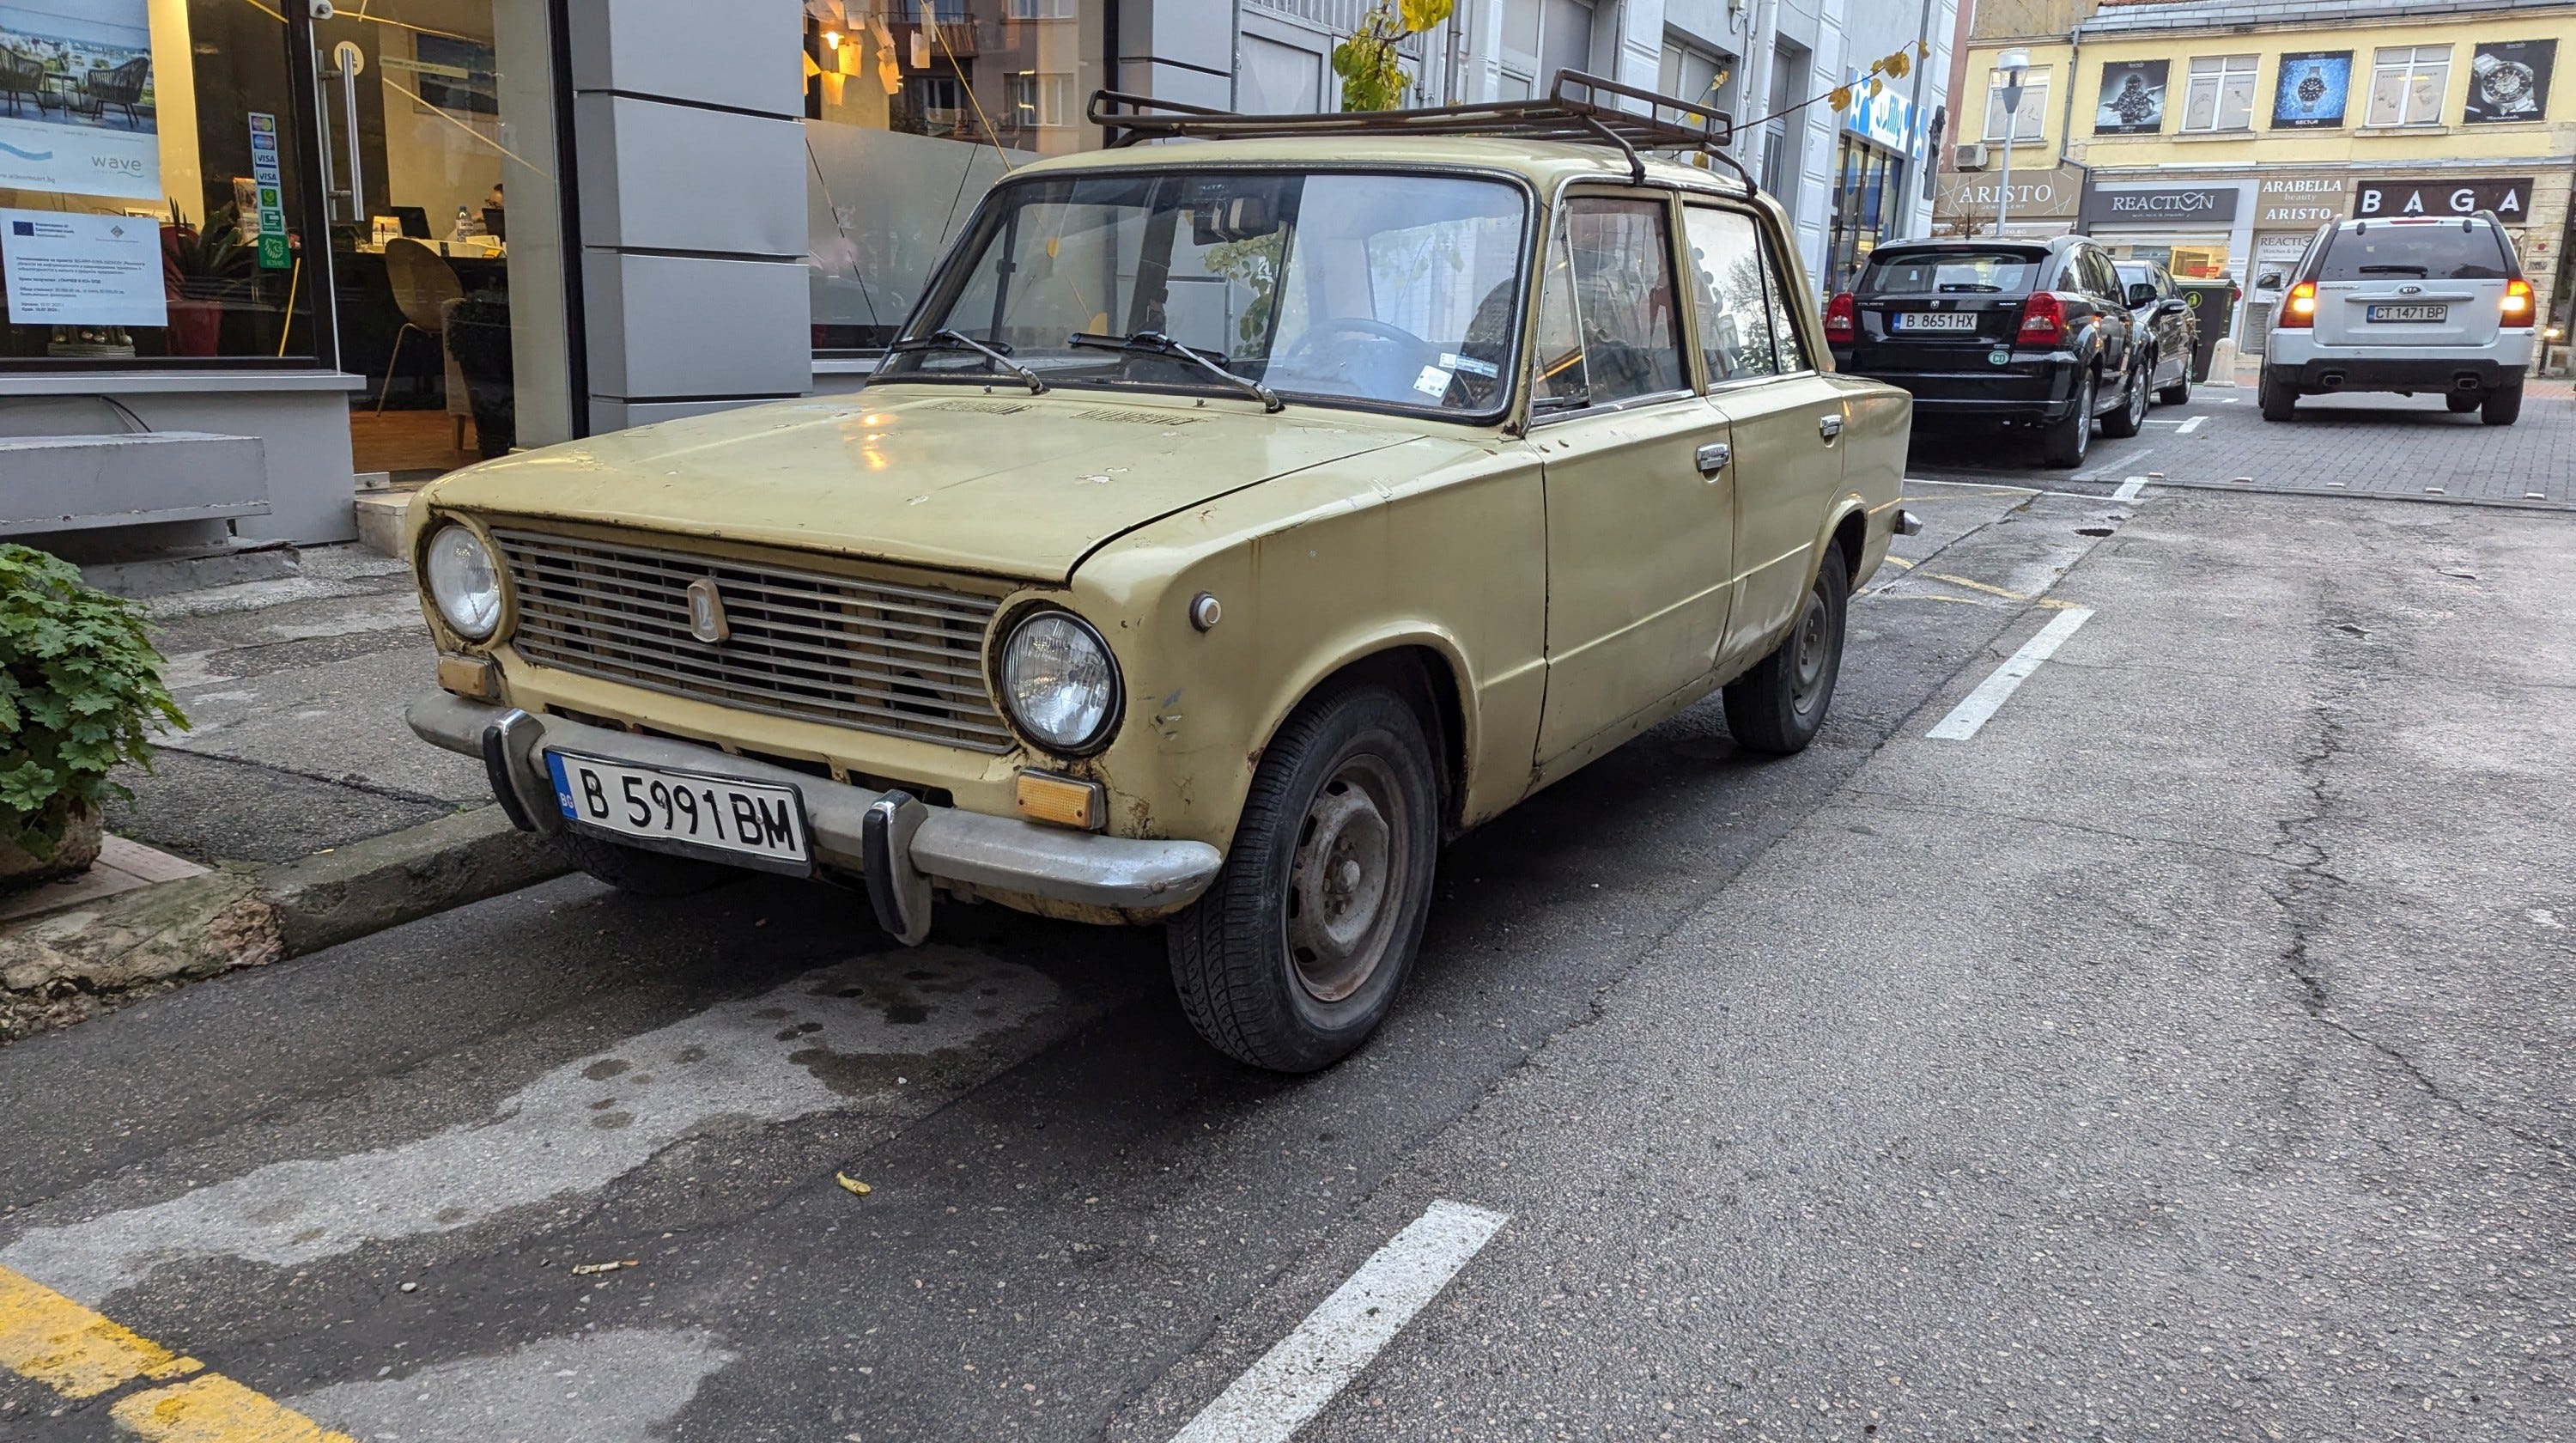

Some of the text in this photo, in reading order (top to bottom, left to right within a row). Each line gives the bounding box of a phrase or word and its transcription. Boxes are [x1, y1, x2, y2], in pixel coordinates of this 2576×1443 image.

[91, 155, 142, 172] wave
[258, 154, 276, 163] VISA
[259, 173, 277, 181] VISA
[2263, 180, 2342, 192] ARABELLA
[1959, 184, 2052, 204] ARISTO
[2285, 193, 2317, 202] beauty
[2361, 188, 2520, 213] BAGA
[2111, 192, 2215, 211] REACTION
[2266, 208, 2331, 220] ARISTO
[2376, 307, 2444, 319] CT 1471 BP
[1906, 314, 1974, 328] B 8651 HX
[1993, 354, 2006, 362] CD
[559, 793, 574, 809] BG
[579, 767, 797, 852] B 5991 BM
